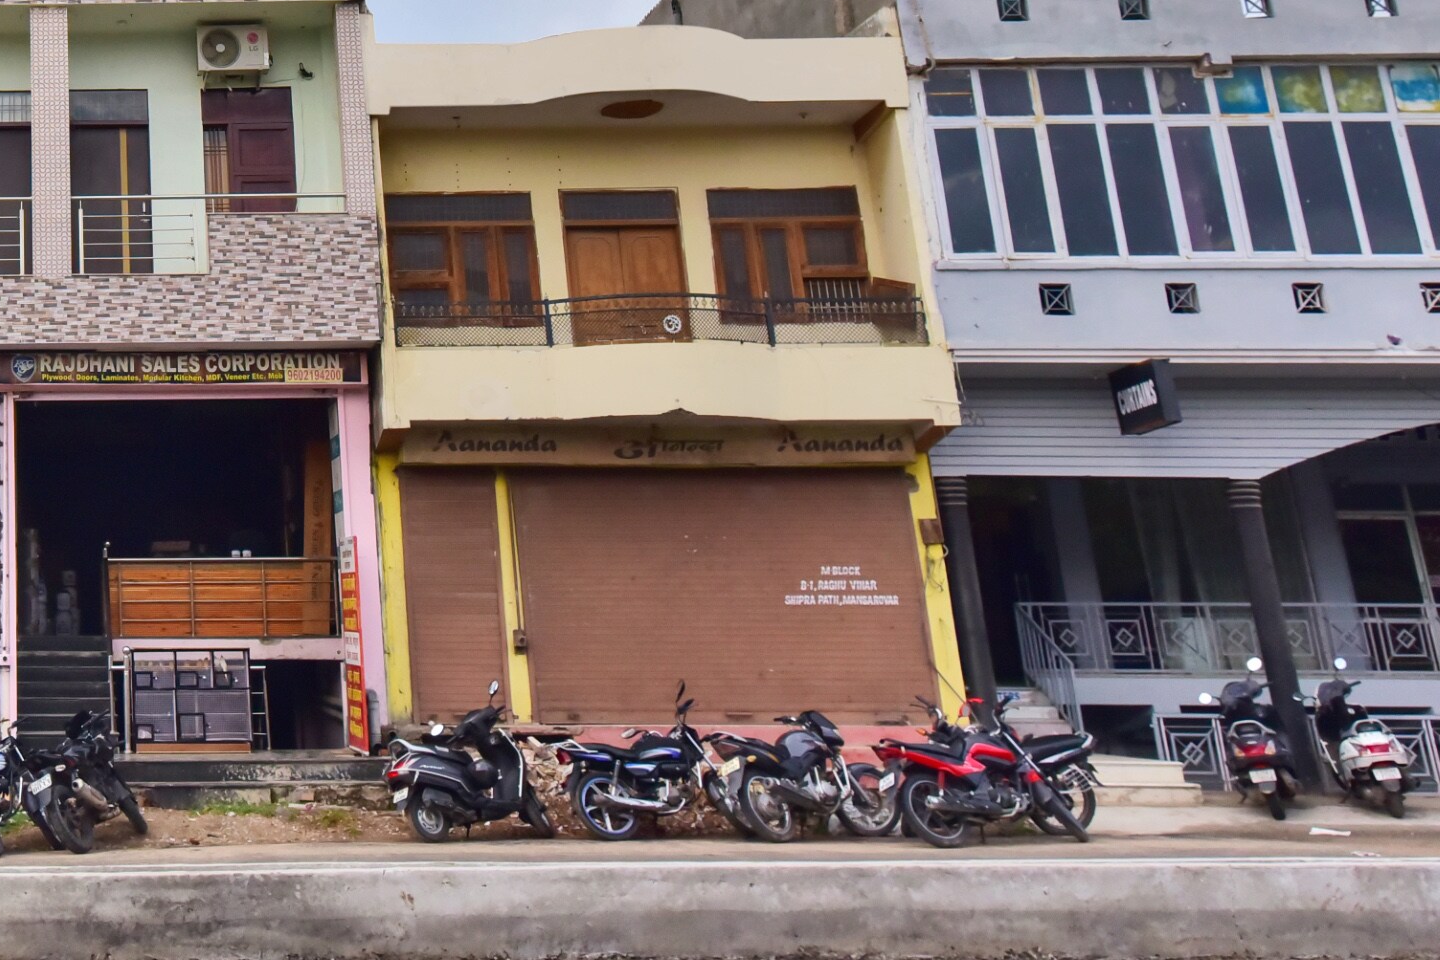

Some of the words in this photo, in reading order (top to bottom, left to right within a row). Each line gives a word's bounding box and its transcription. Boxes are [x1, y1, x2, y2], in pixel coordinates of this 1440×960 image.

[40, 355, 135, 373] RAJDHANI
[141, 354, 201, 373] SALES
[205, 353, 340, 372] CORPORATION
[76, 373, 100, 382] Doors,
[174, 373, 205, 383] Kitchen,
[225, 373, 250, 381] Veneer
[252, 372, 266, 380] Etc.
[268, 372, 283, 380] Mob
[287, 370, 341, 381] 9602194200
[1117, 378, 1158, 416] CURTAINS
[431, 429, 557, 452] Aananda
[777, 427, 904, 452] Aananda
[784, 595, 816, 605] SHIPRA
